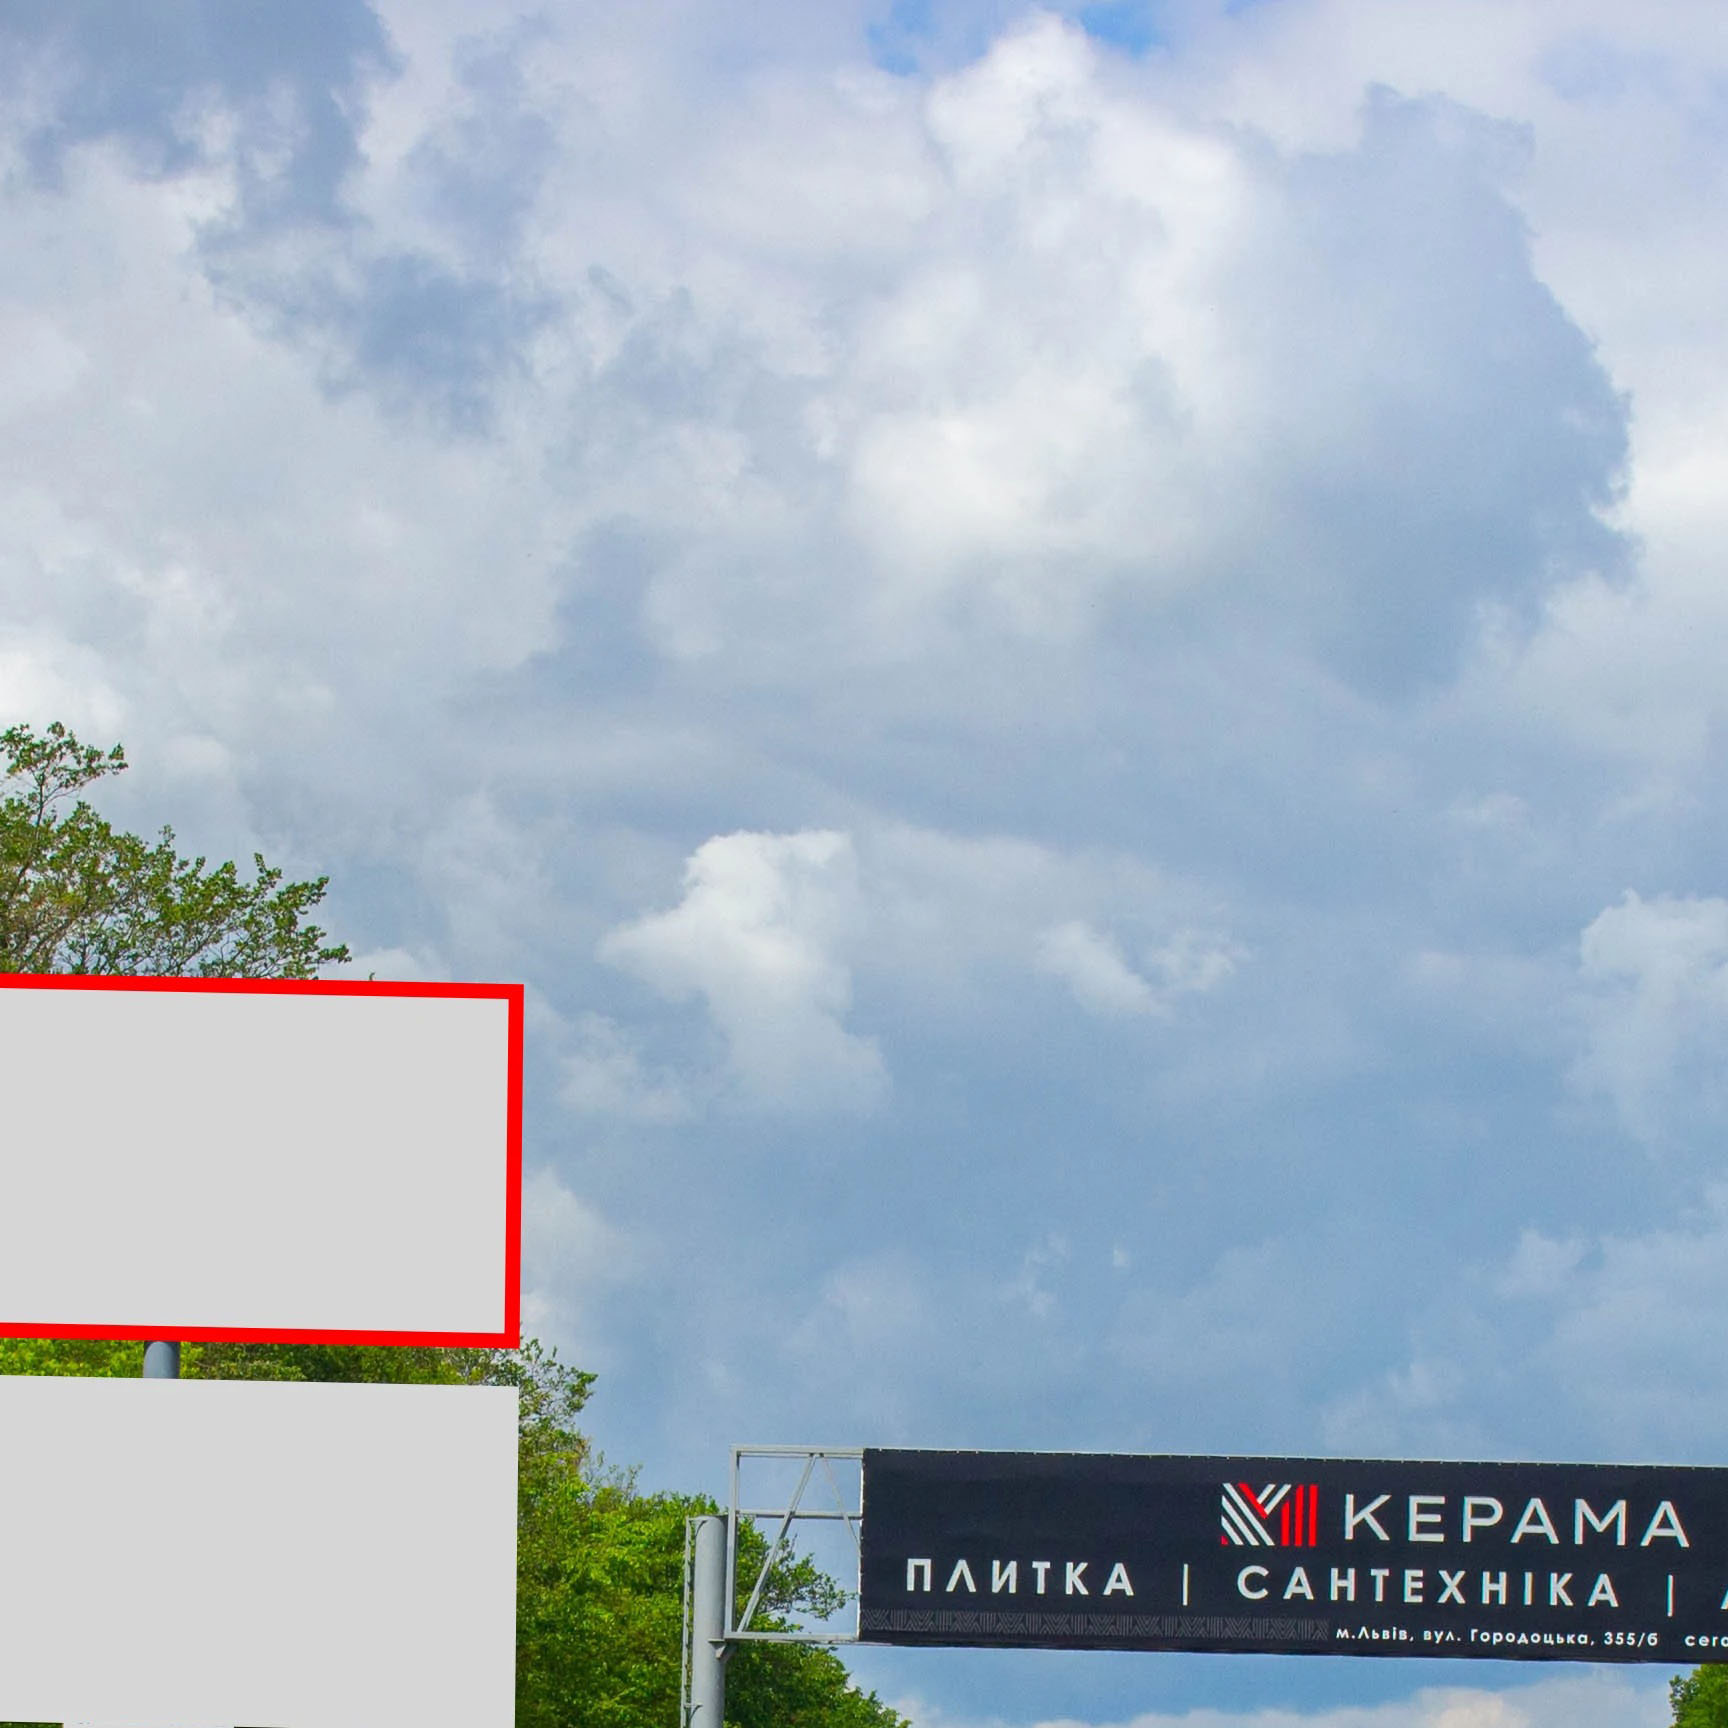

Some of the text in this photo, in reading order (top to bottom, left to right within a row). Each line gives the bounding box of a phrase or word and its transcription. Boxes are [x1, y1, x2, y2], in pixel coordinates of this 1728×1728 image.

[1344, 1493, 1690, 1548] КЕРАМА
[906, 1558, 1135, 1597] ПЛИТКА
[1237, 1565, 1619, 1608] САНТЕХНІКА
[1423, 1630, 1462, 1644] вул.
[1470, 1628, 1595, 1646] Городоцька,
